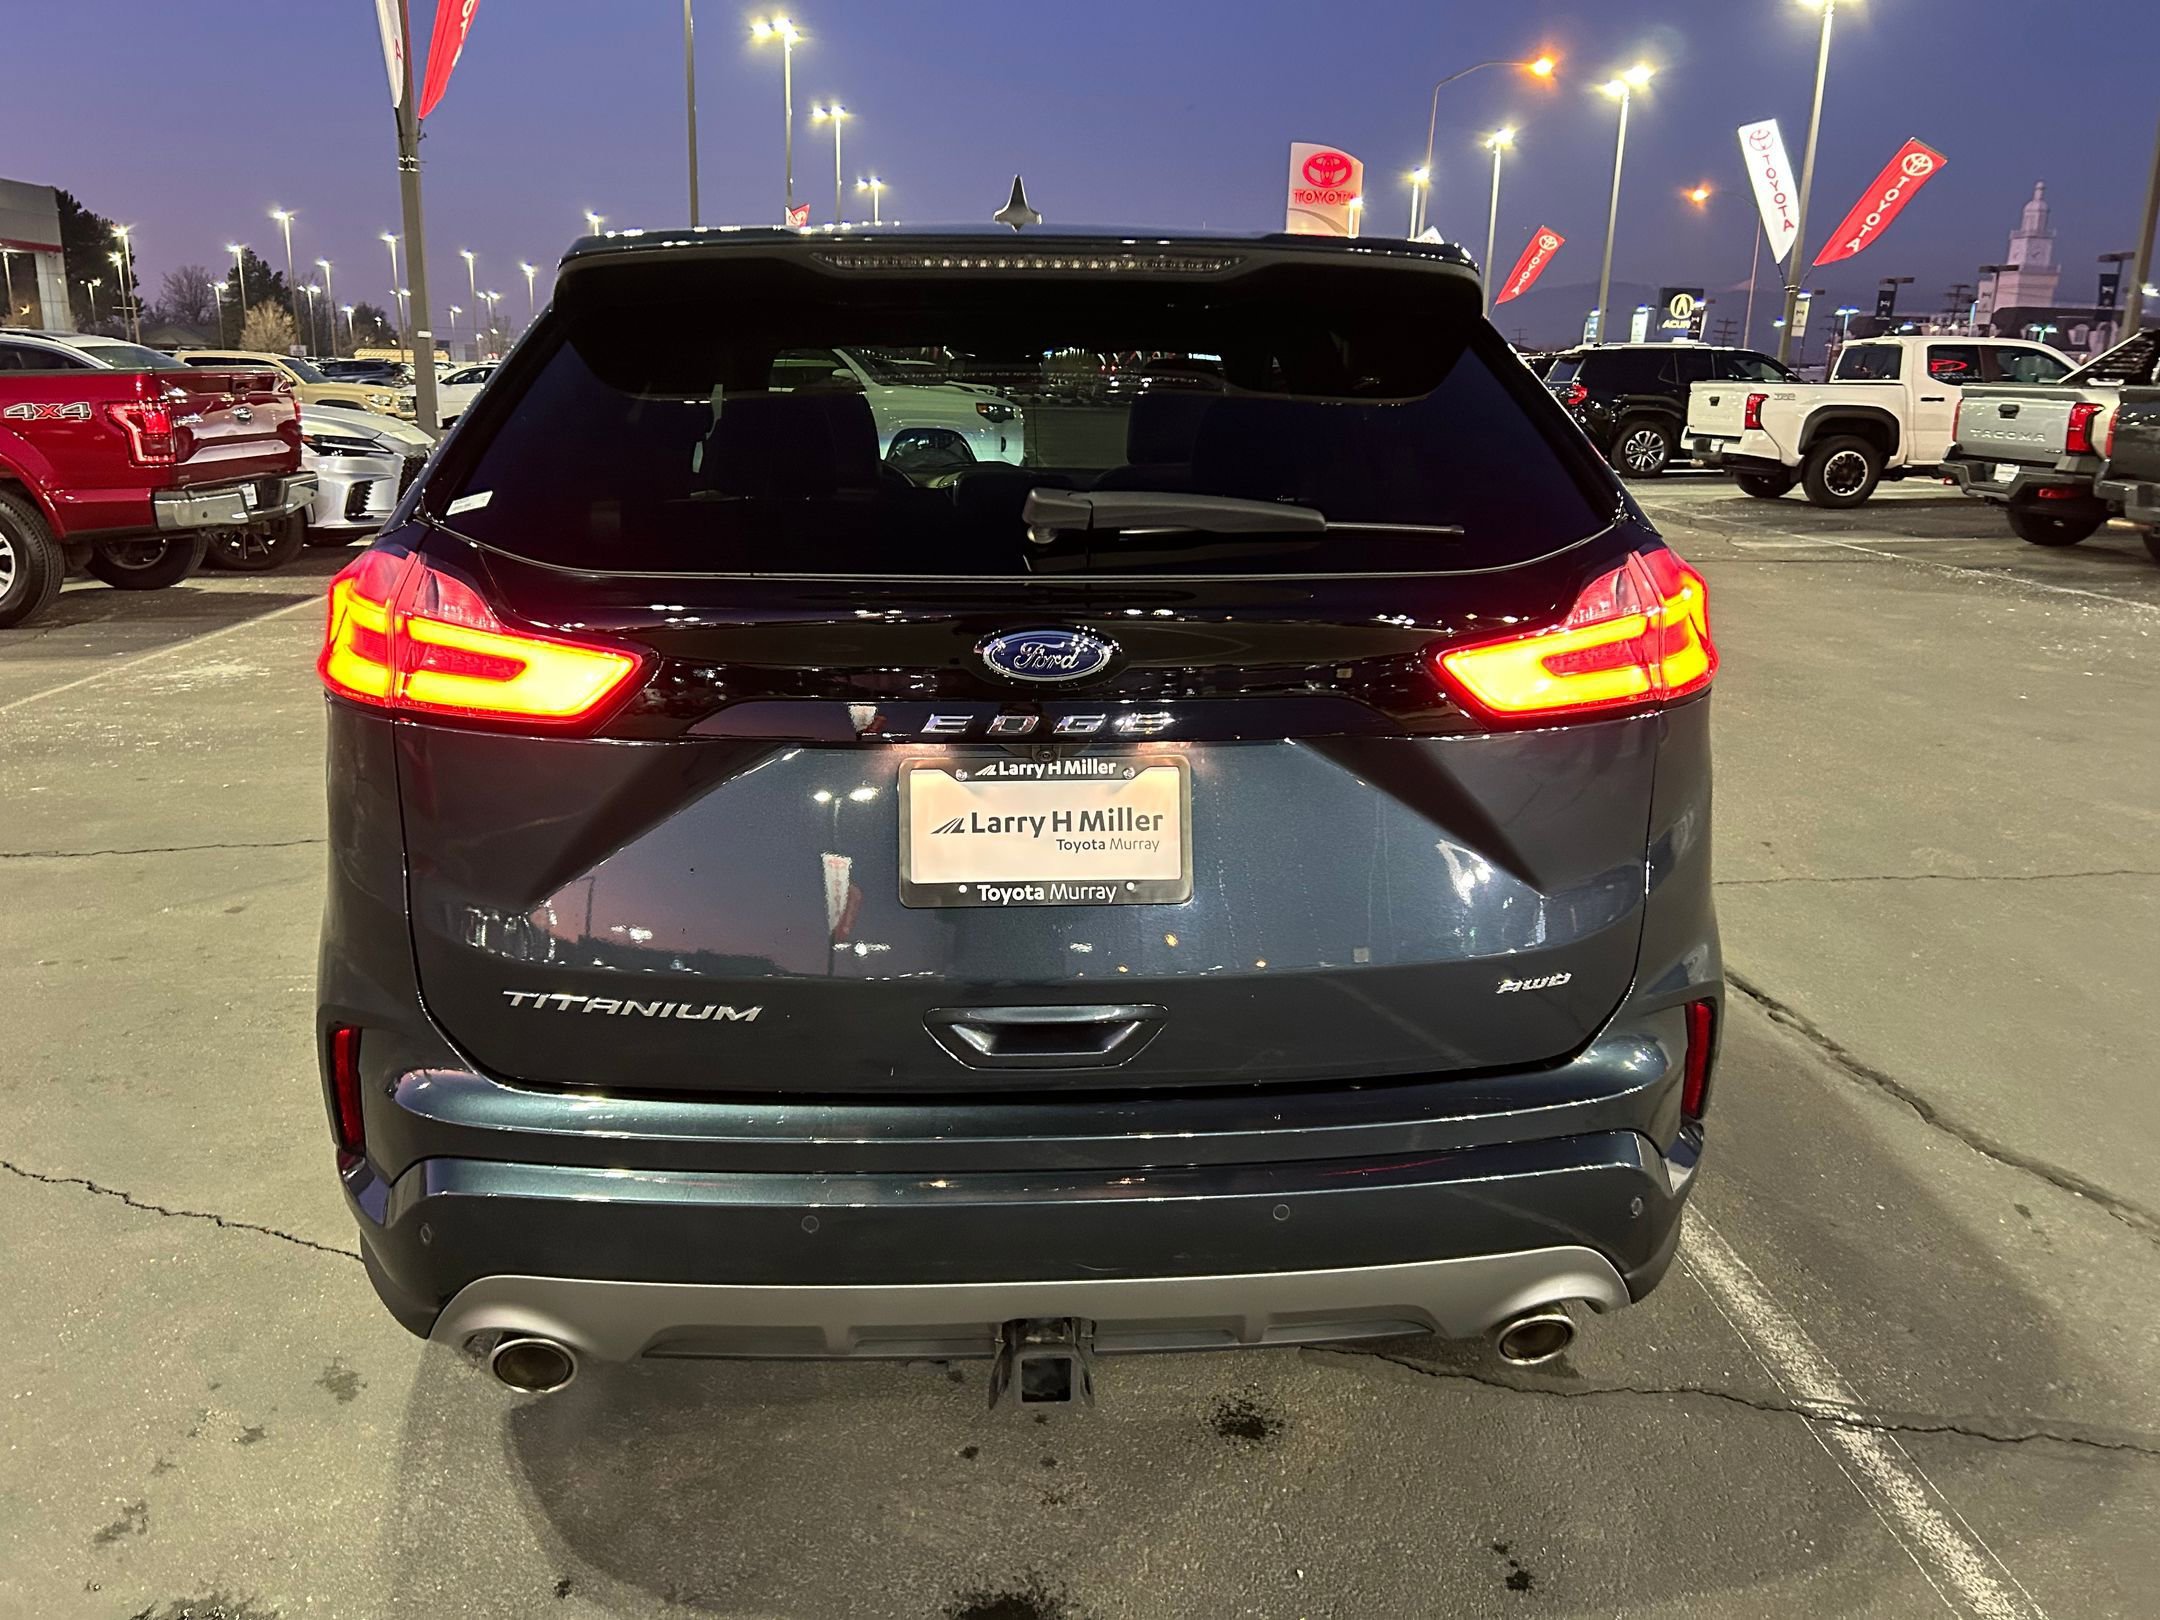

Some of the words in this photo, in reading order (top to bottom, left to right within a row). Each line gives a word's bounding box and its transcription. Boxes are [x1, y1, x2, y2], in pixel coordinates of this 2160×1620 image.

[1762, 154, 1795, 232] TOYOTA
[1846, 176, 1911, 252] TOYOTA
[1511, 249, 1546, 295] TOYOTA
[1968, 428, 2047, 443] TACOMA
[1014, 641, 1080, 670] Ford
[921, 712, 1173, 734] EDGE
[999, 761, 1044, 778] Larry
[1048, 763, 1062, 775] H
[1064, 759, 1116, 775] Miller
[971, 812, 1046, 838] Larry
[1052, 810, 1072, 832] H
[1079, 807, 1163, 832] Miller
[1056, 838, 1105, 854] Toyota
[1109, 838, 1160, 853] Murray
[977, 884, 1044, 905] Toyota
[1049, 883, 1117, 903] Murray
[1496, 972, 1572, 994] AWD
[502, 990, 765, 1022] TITANIUM
